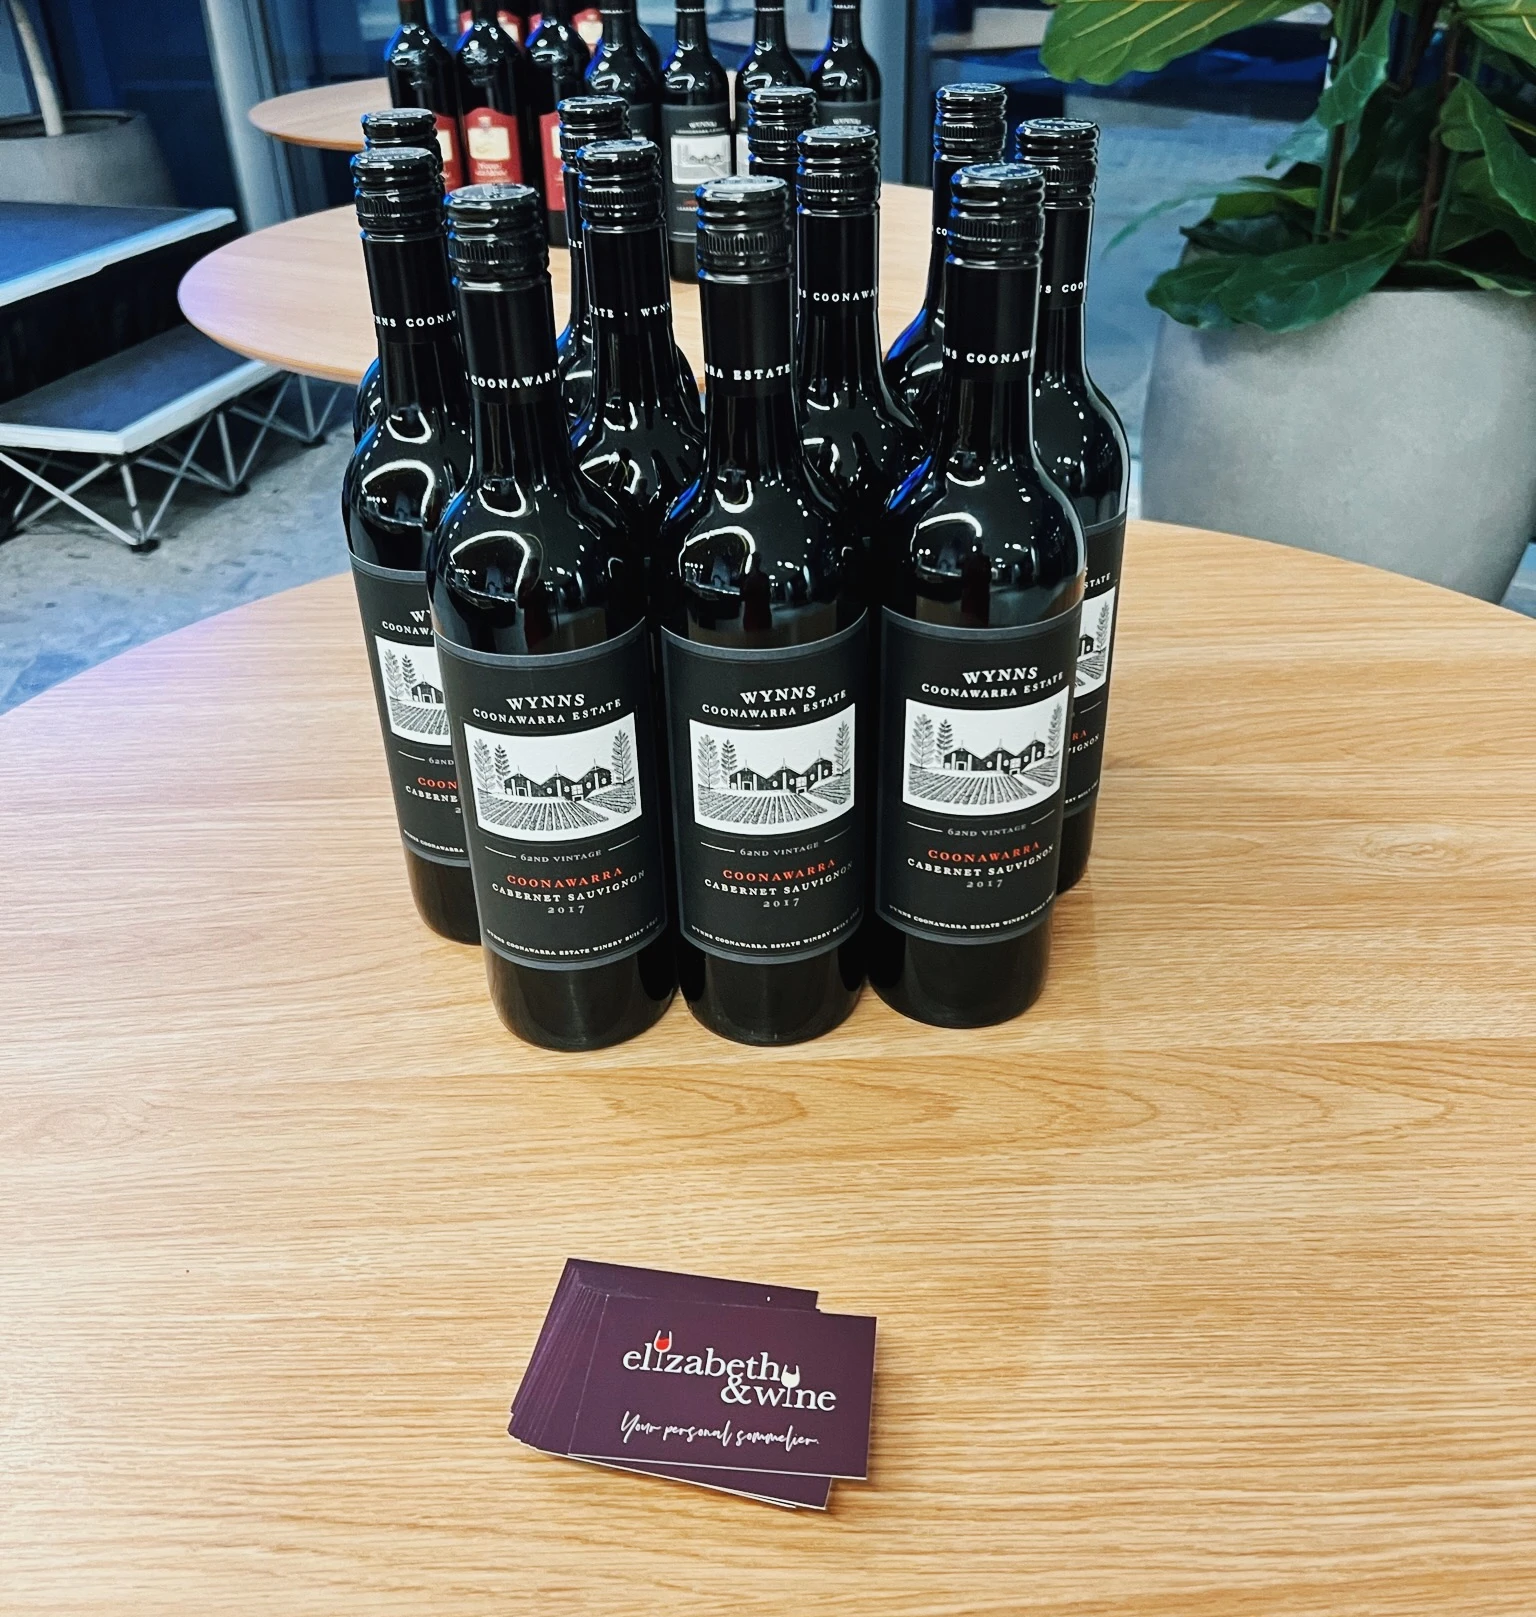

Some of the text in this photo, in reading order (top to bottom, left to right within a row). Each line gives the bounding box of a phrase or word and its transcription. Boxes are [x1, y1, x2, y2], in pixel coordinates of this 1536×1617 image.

[375, 315, 396, 327] NNS
[733, 363, 791, 381] ESTATE
[1083, 572, 1111, 589] STATE
[962, 666, 1039, 684] WYNNS
[921, 671, 1064, 699] COONAWARRA ESTATE
[506, 693, 586, 710] WYNNS
[701, 689, 847, 719] COONAWARRA ESTATE
[740, 685, 817, 705] WYNNS
[472, 698, 621, 725] COONAWARRA ESTATE
[405, 785, 458, 803] CABERNE
[981, 823, 1027, 837] VINTAGE
[553, 850, 603, 863] VINTAGE
[773, 841, 820, 857] VINTAGE
[928, 840, 1041, 864] COONAWARRA
[907, 843, 1055, 878] CABERNET SAUVIGNON
[506, 867, 623, 889] COONAWARRA
[704, 860, 854, 897] CABERNET SAUVIGNON
[723, 858, 836, 883] COONAWARRA
[491, 869, 646, 903] CABERNET SAUVIGNON
[966, 879, 1004, 889] 2017
[547, 904, 586, 915] 2017
[763, 897, 800, 909] 2017
[622, 1330, 780, 1382] elizabeth
[620, 1410, 661, 1443] Your
[663, 1420, 732, 1447] personal
